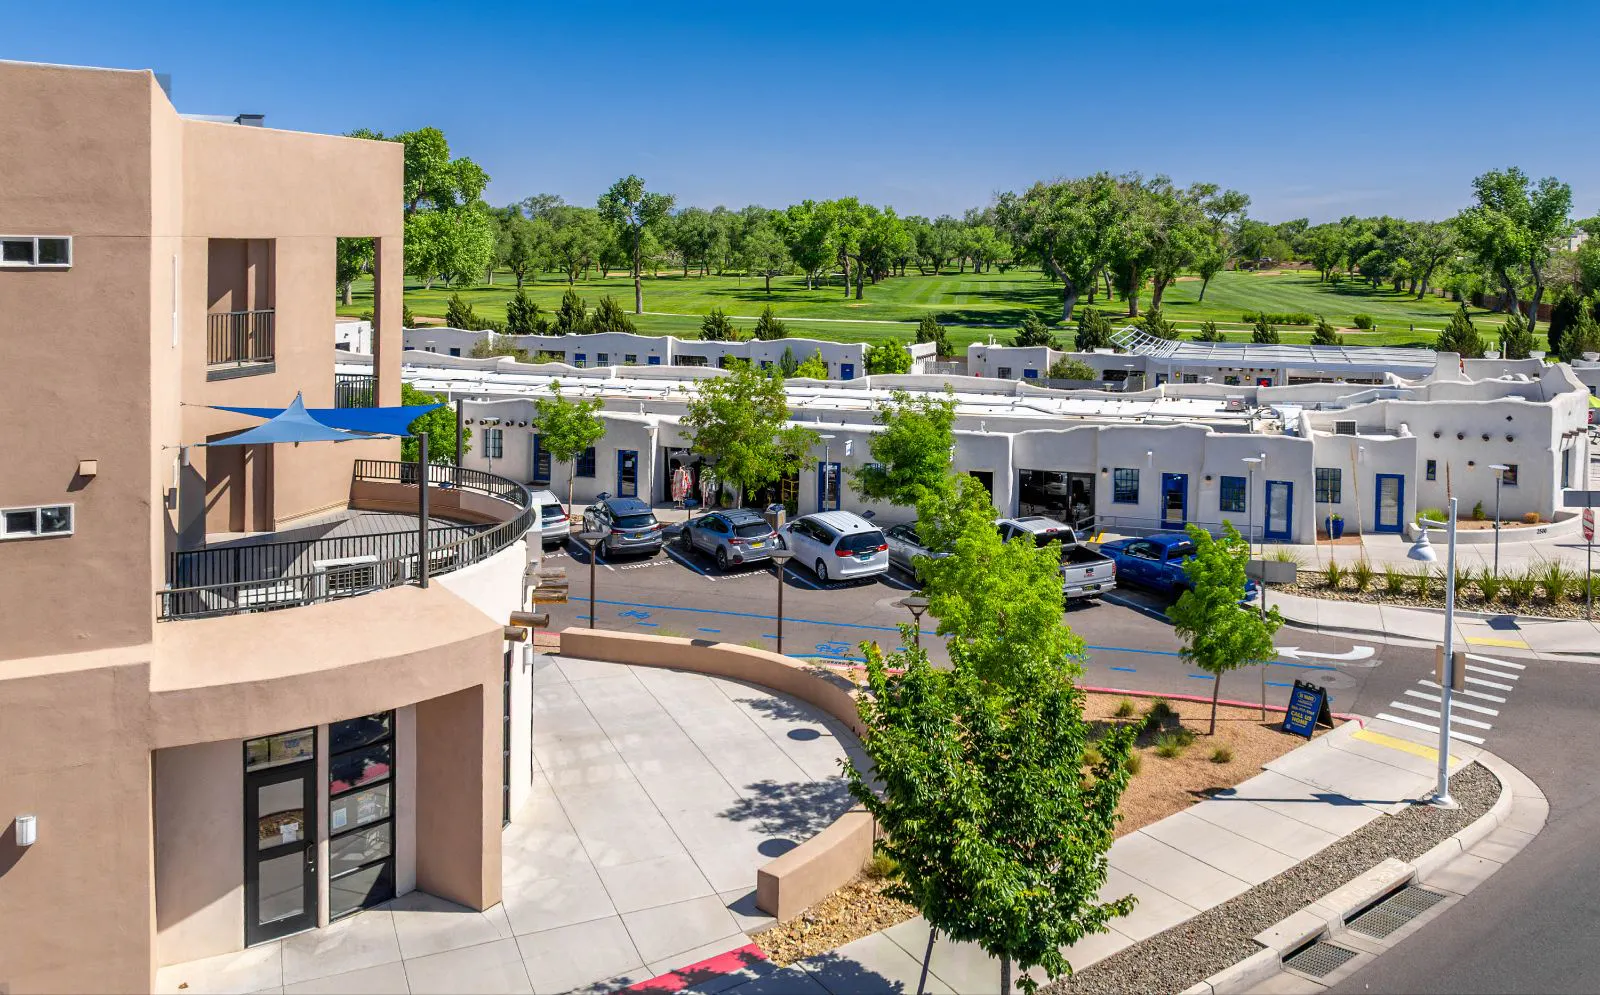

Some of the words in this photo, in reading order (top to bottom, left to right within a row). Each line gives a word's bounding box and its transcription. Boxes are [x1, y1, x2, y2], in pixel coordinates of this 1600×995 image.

[620, 559, 675, 570] COMPACT
[1291, 710, 1303, 719] CALL
[1304, 714, 1312, 722] US
[1291, 716, 1308, 726] HOME
